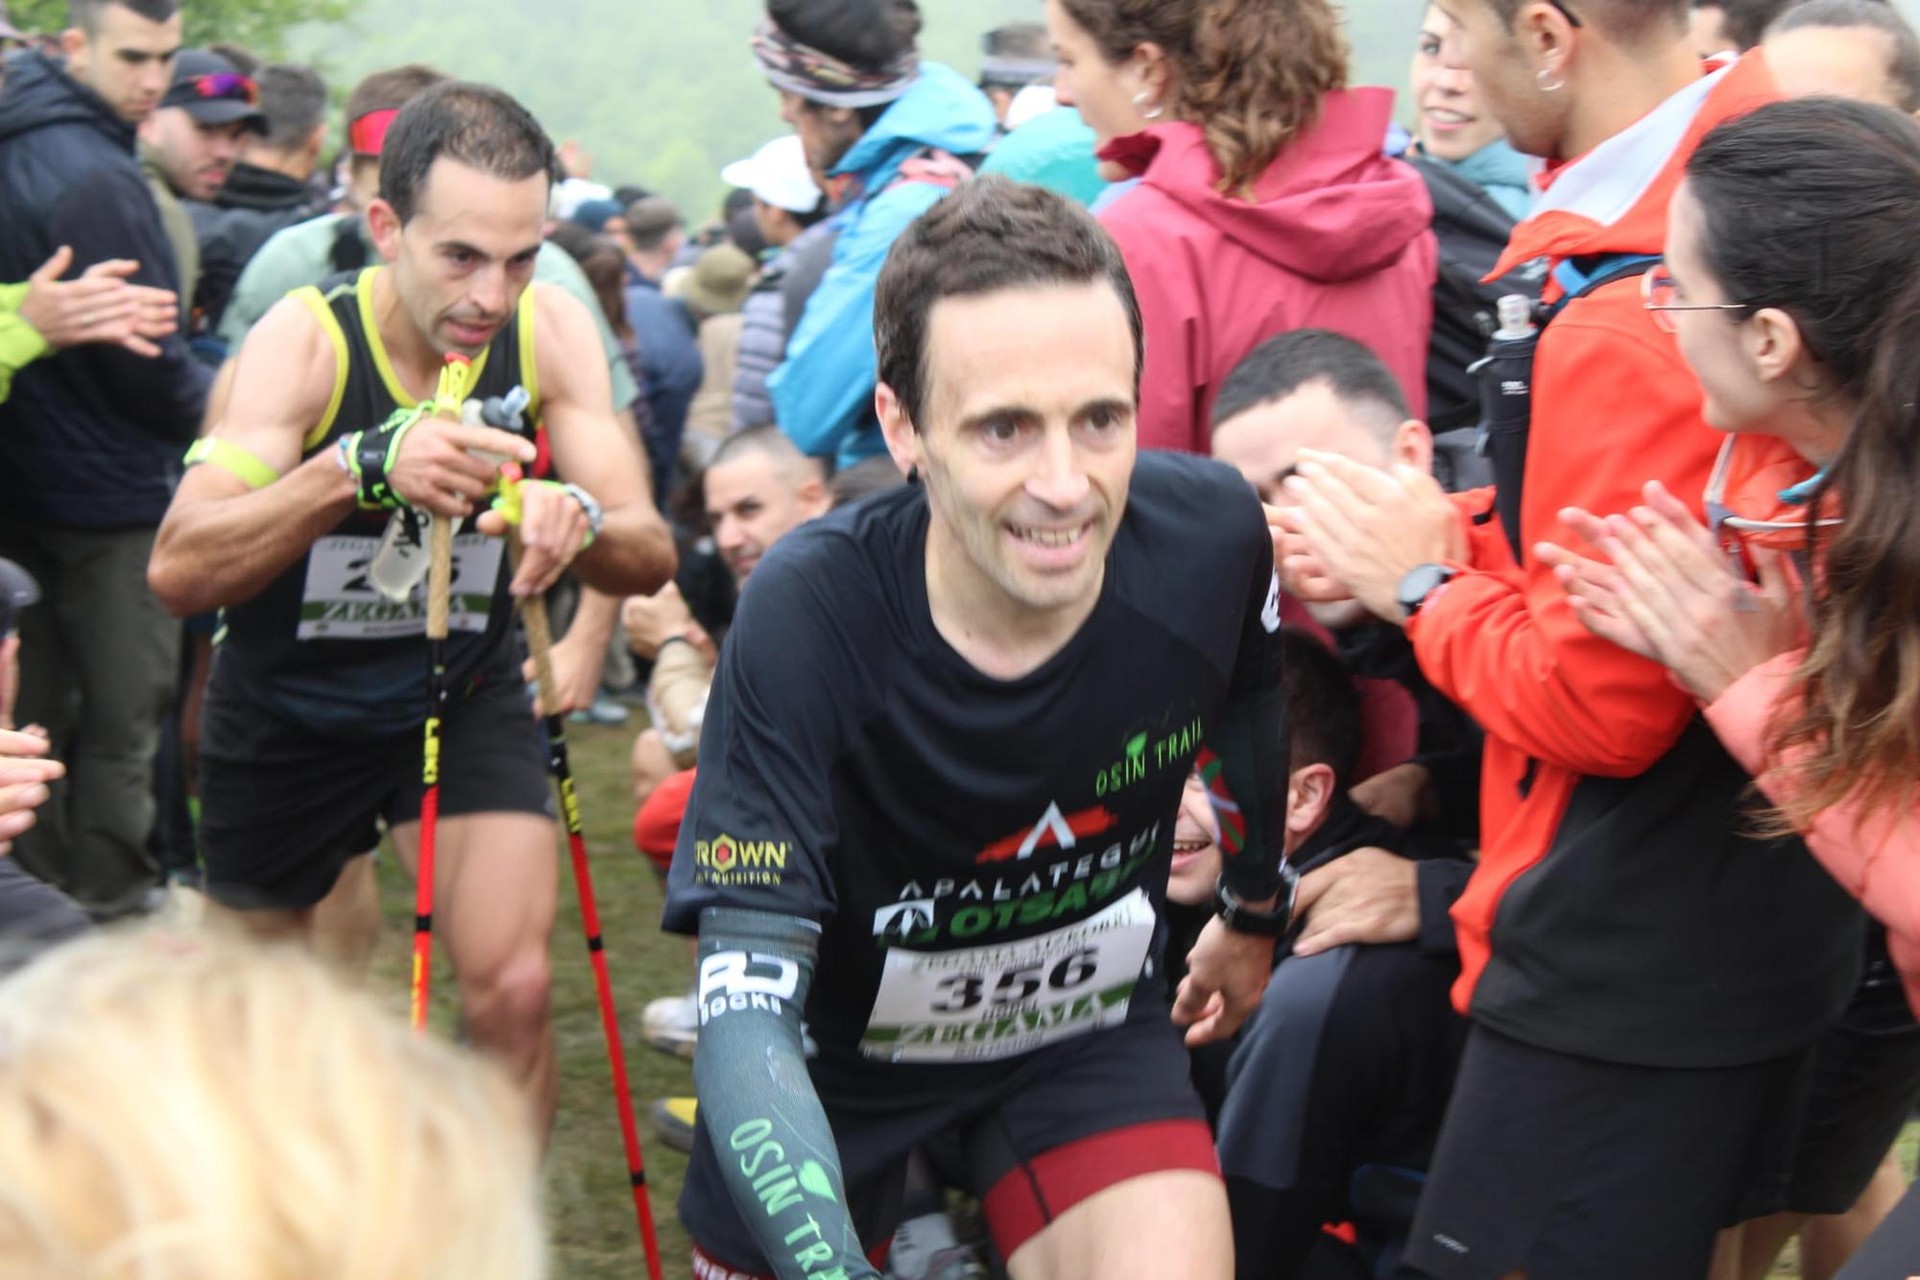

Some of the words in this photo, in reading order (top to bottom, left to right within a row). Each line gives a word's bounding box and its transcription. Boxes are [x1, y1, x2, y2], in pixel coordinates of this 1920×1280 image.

[1096, 752, 1146, 798] OSIN
[694, 832, 787, 875] ROWN
[930, 948, 1098, 1013] 356
[730, 1118, 804, 1217] OSIN
